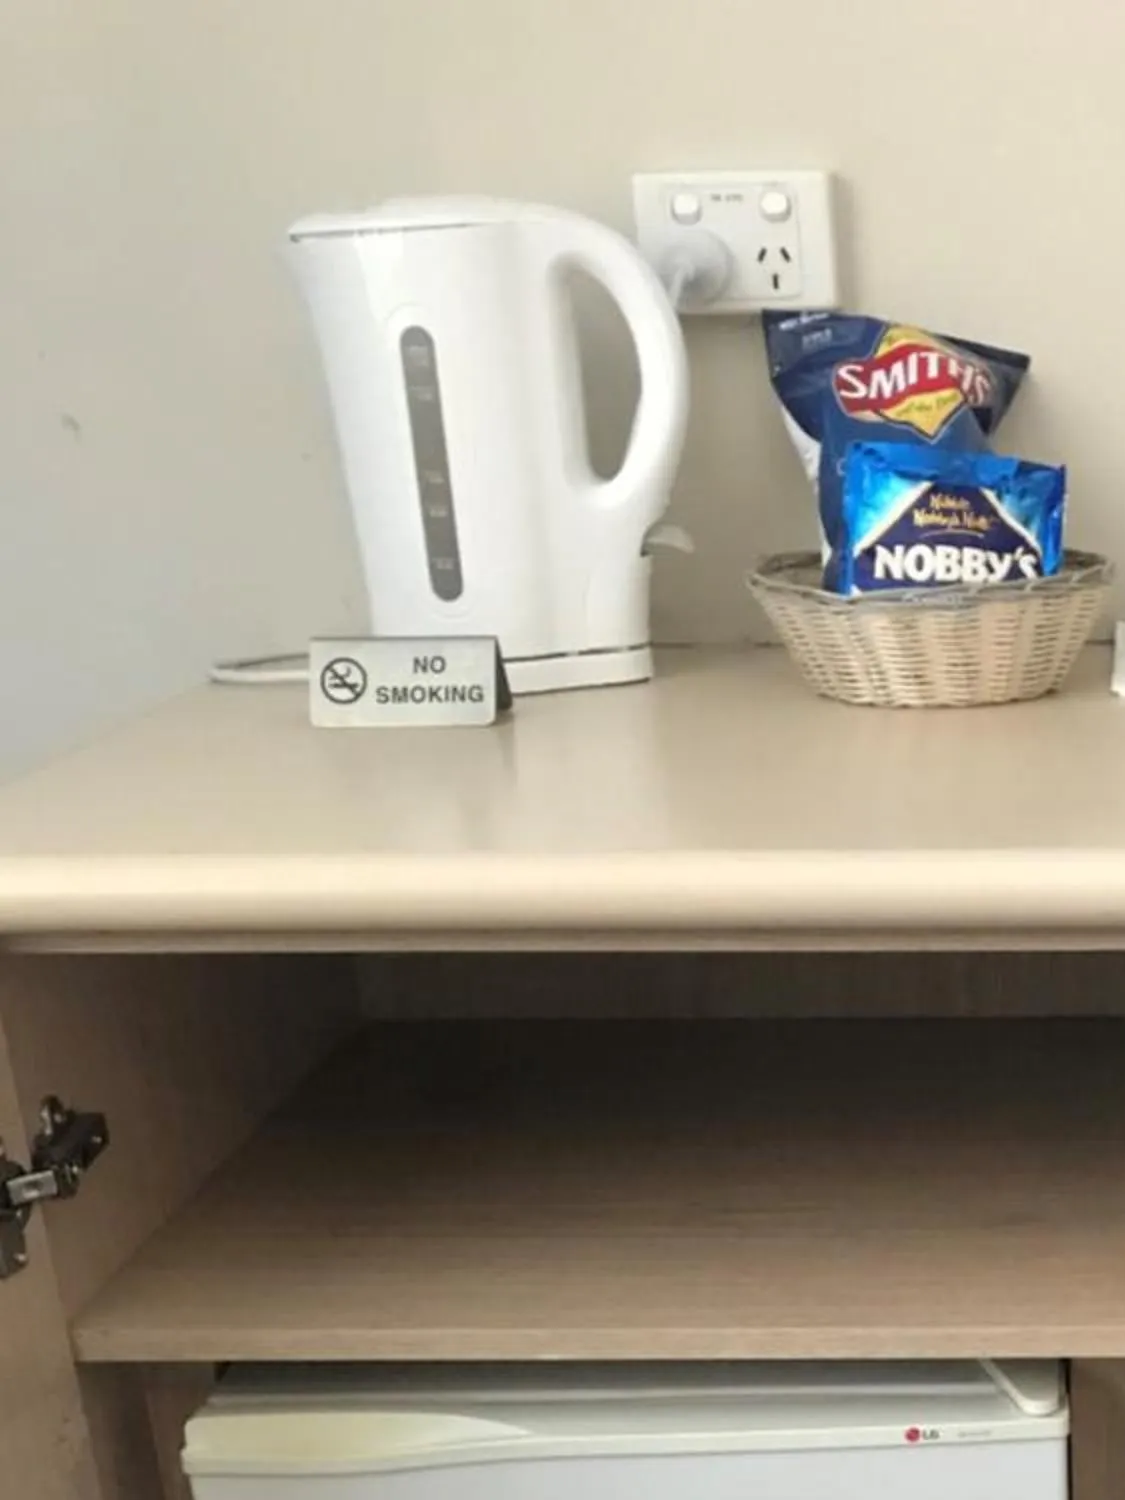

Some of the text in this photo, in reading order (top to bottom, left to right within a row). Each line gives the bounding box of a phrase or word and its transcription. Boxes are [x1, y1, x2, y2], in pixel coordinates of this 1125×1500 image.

[836, 350, 992, 406] SMITH'S
[873, 544, 1041, 583] NOBBY'S
[412, 655, 447, 675] NO
[375, 684, 485, 705] SMOKING
[922, 1428, 941, 1441] LG
